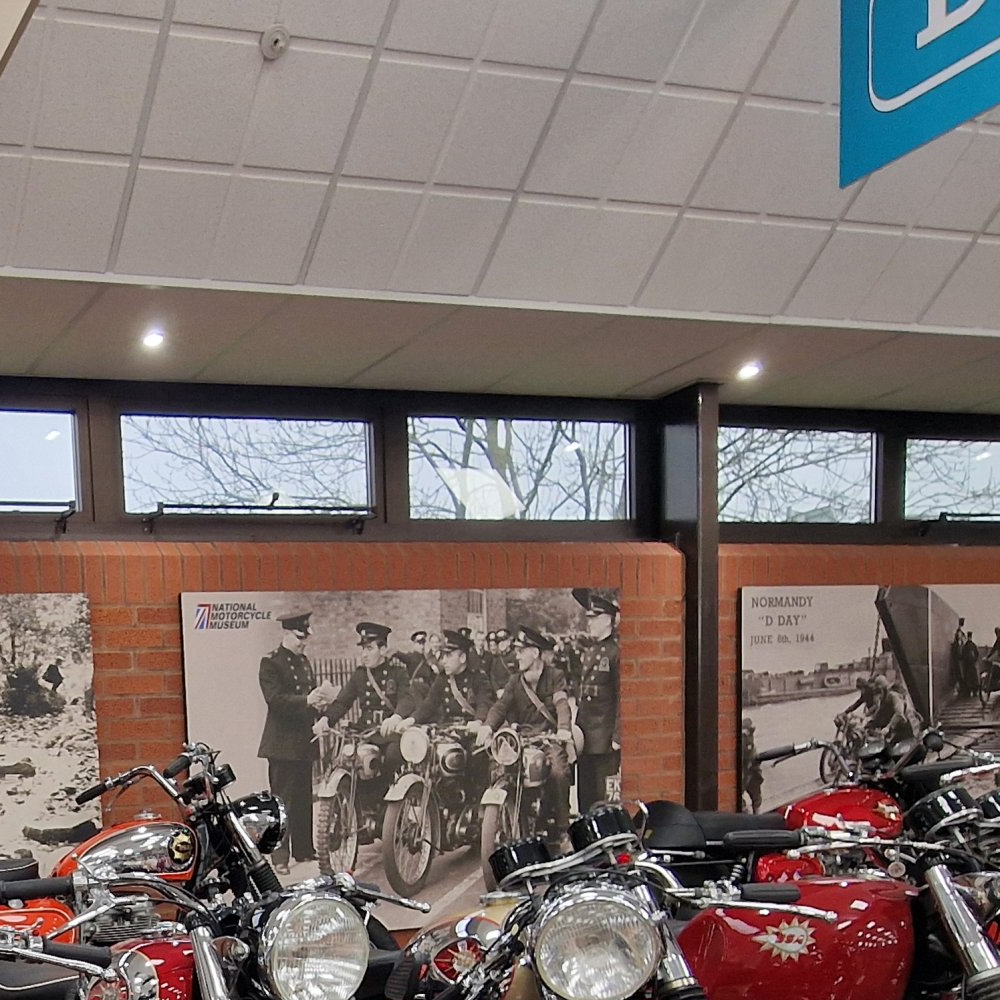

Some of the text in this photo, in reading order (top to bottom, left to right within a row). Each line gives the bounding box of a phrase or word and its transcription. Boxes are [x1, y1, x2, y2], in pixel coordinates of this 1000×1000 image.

[751, 596, 813, 608] NORMANDY
[212, 603, 257, 612] NATIONAL
[211, 611, 271, 621] MOTORCYCLE
[210, 620, 249, 630] MUSEUM
[750, 635, 773, 646] JUNE
[796, 634, 815, 643] 1944
